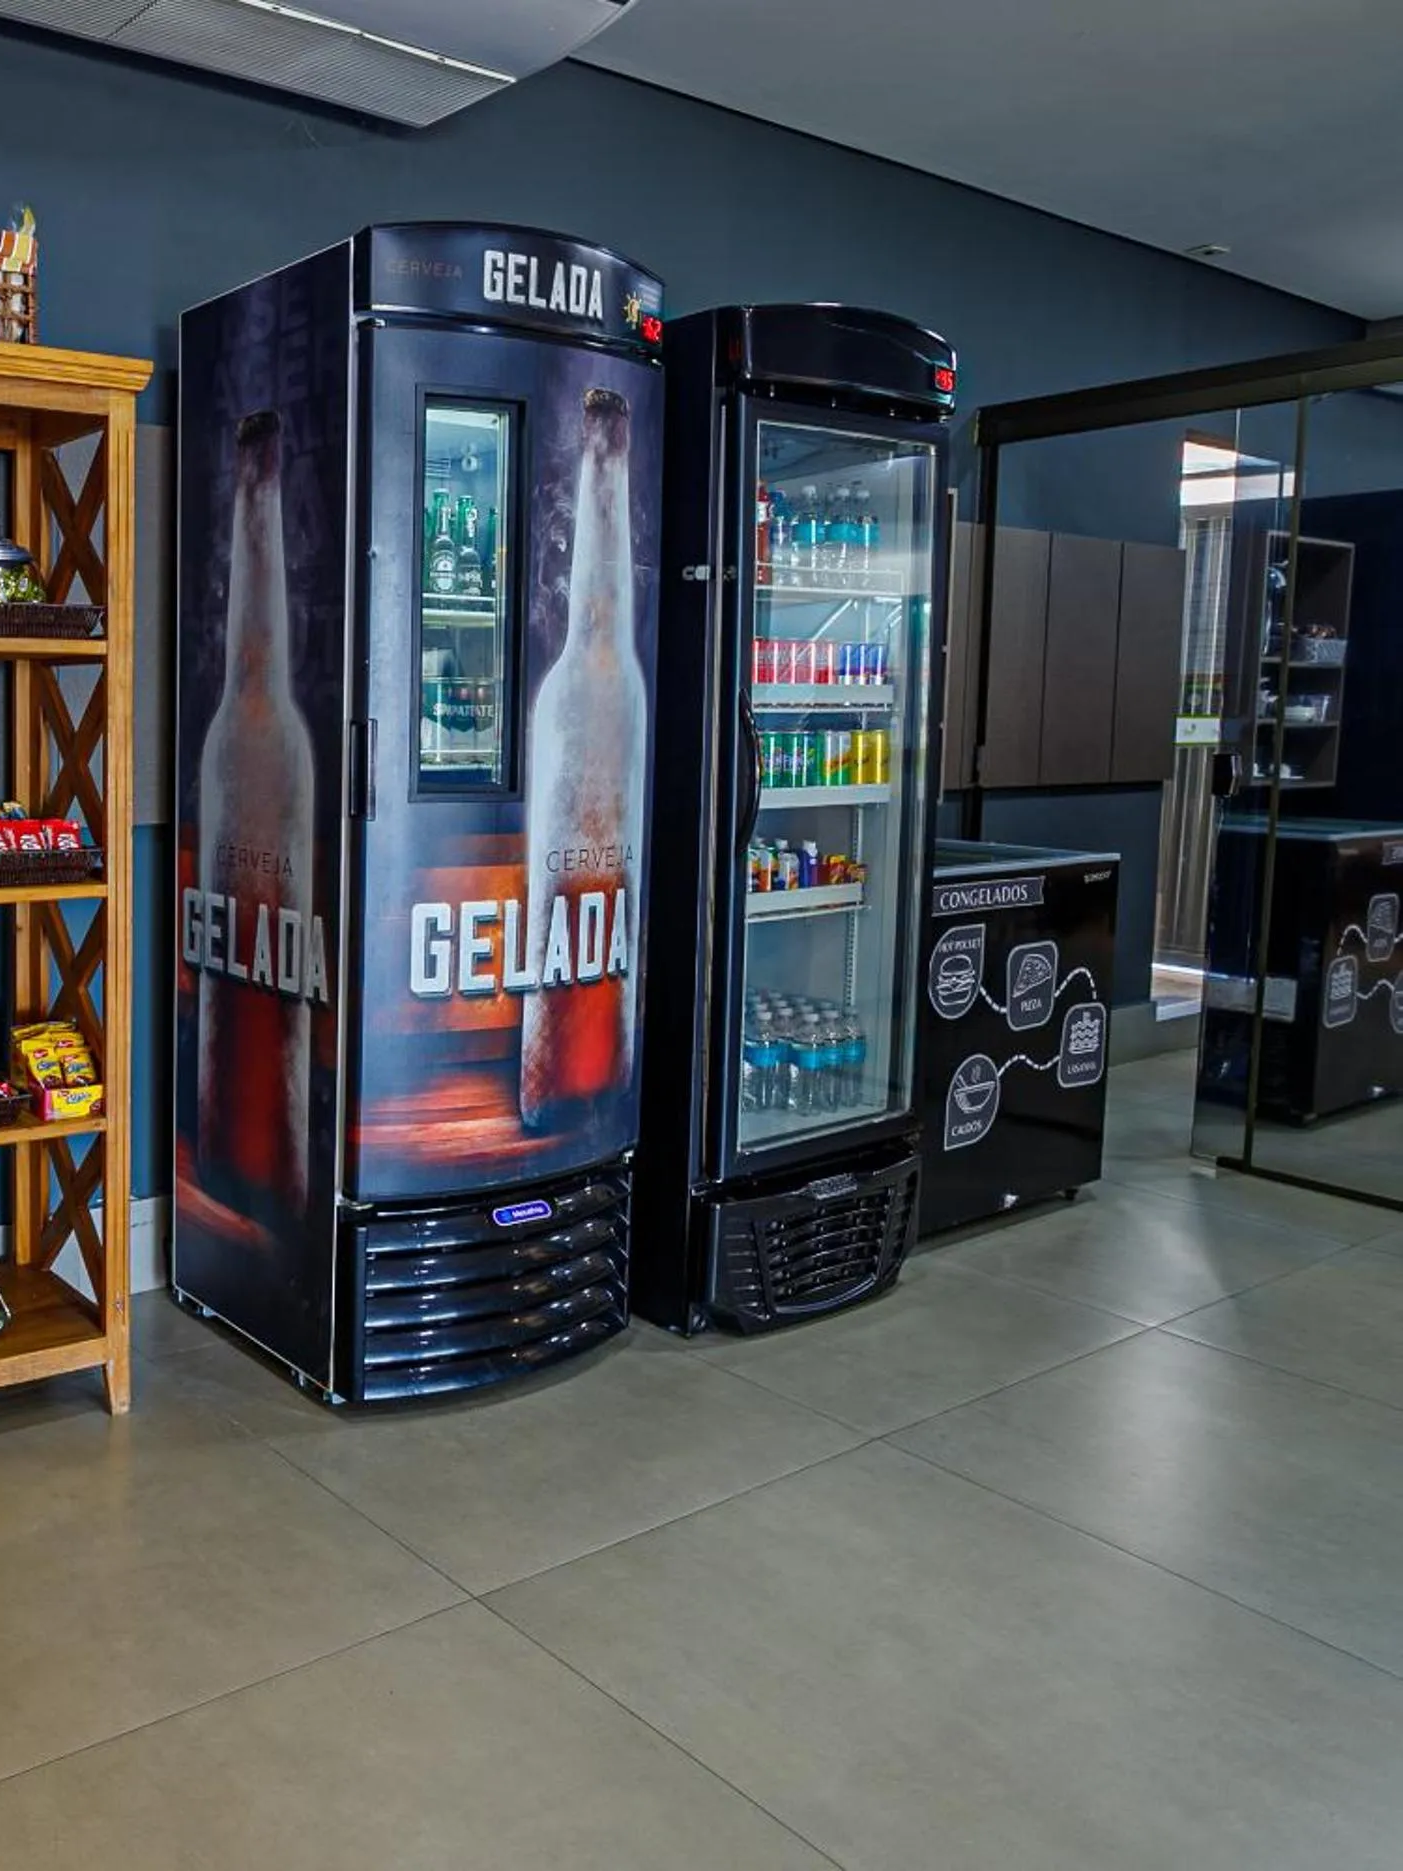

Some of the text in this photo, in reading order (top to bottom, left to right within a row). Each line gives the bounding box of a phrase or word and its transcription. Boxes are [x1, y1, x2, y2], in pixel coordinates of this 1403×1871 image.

[483, 250, 604, 320] GELADA
[215, 843, 295, 878] CERVEJA
[546, 843, 635, 874] CERVEJA
[940, 884, 1028, 910] CONGELADOS
[182, 886, 331, 1004] GELADA
[411, 888, 630, 999] GELADA
